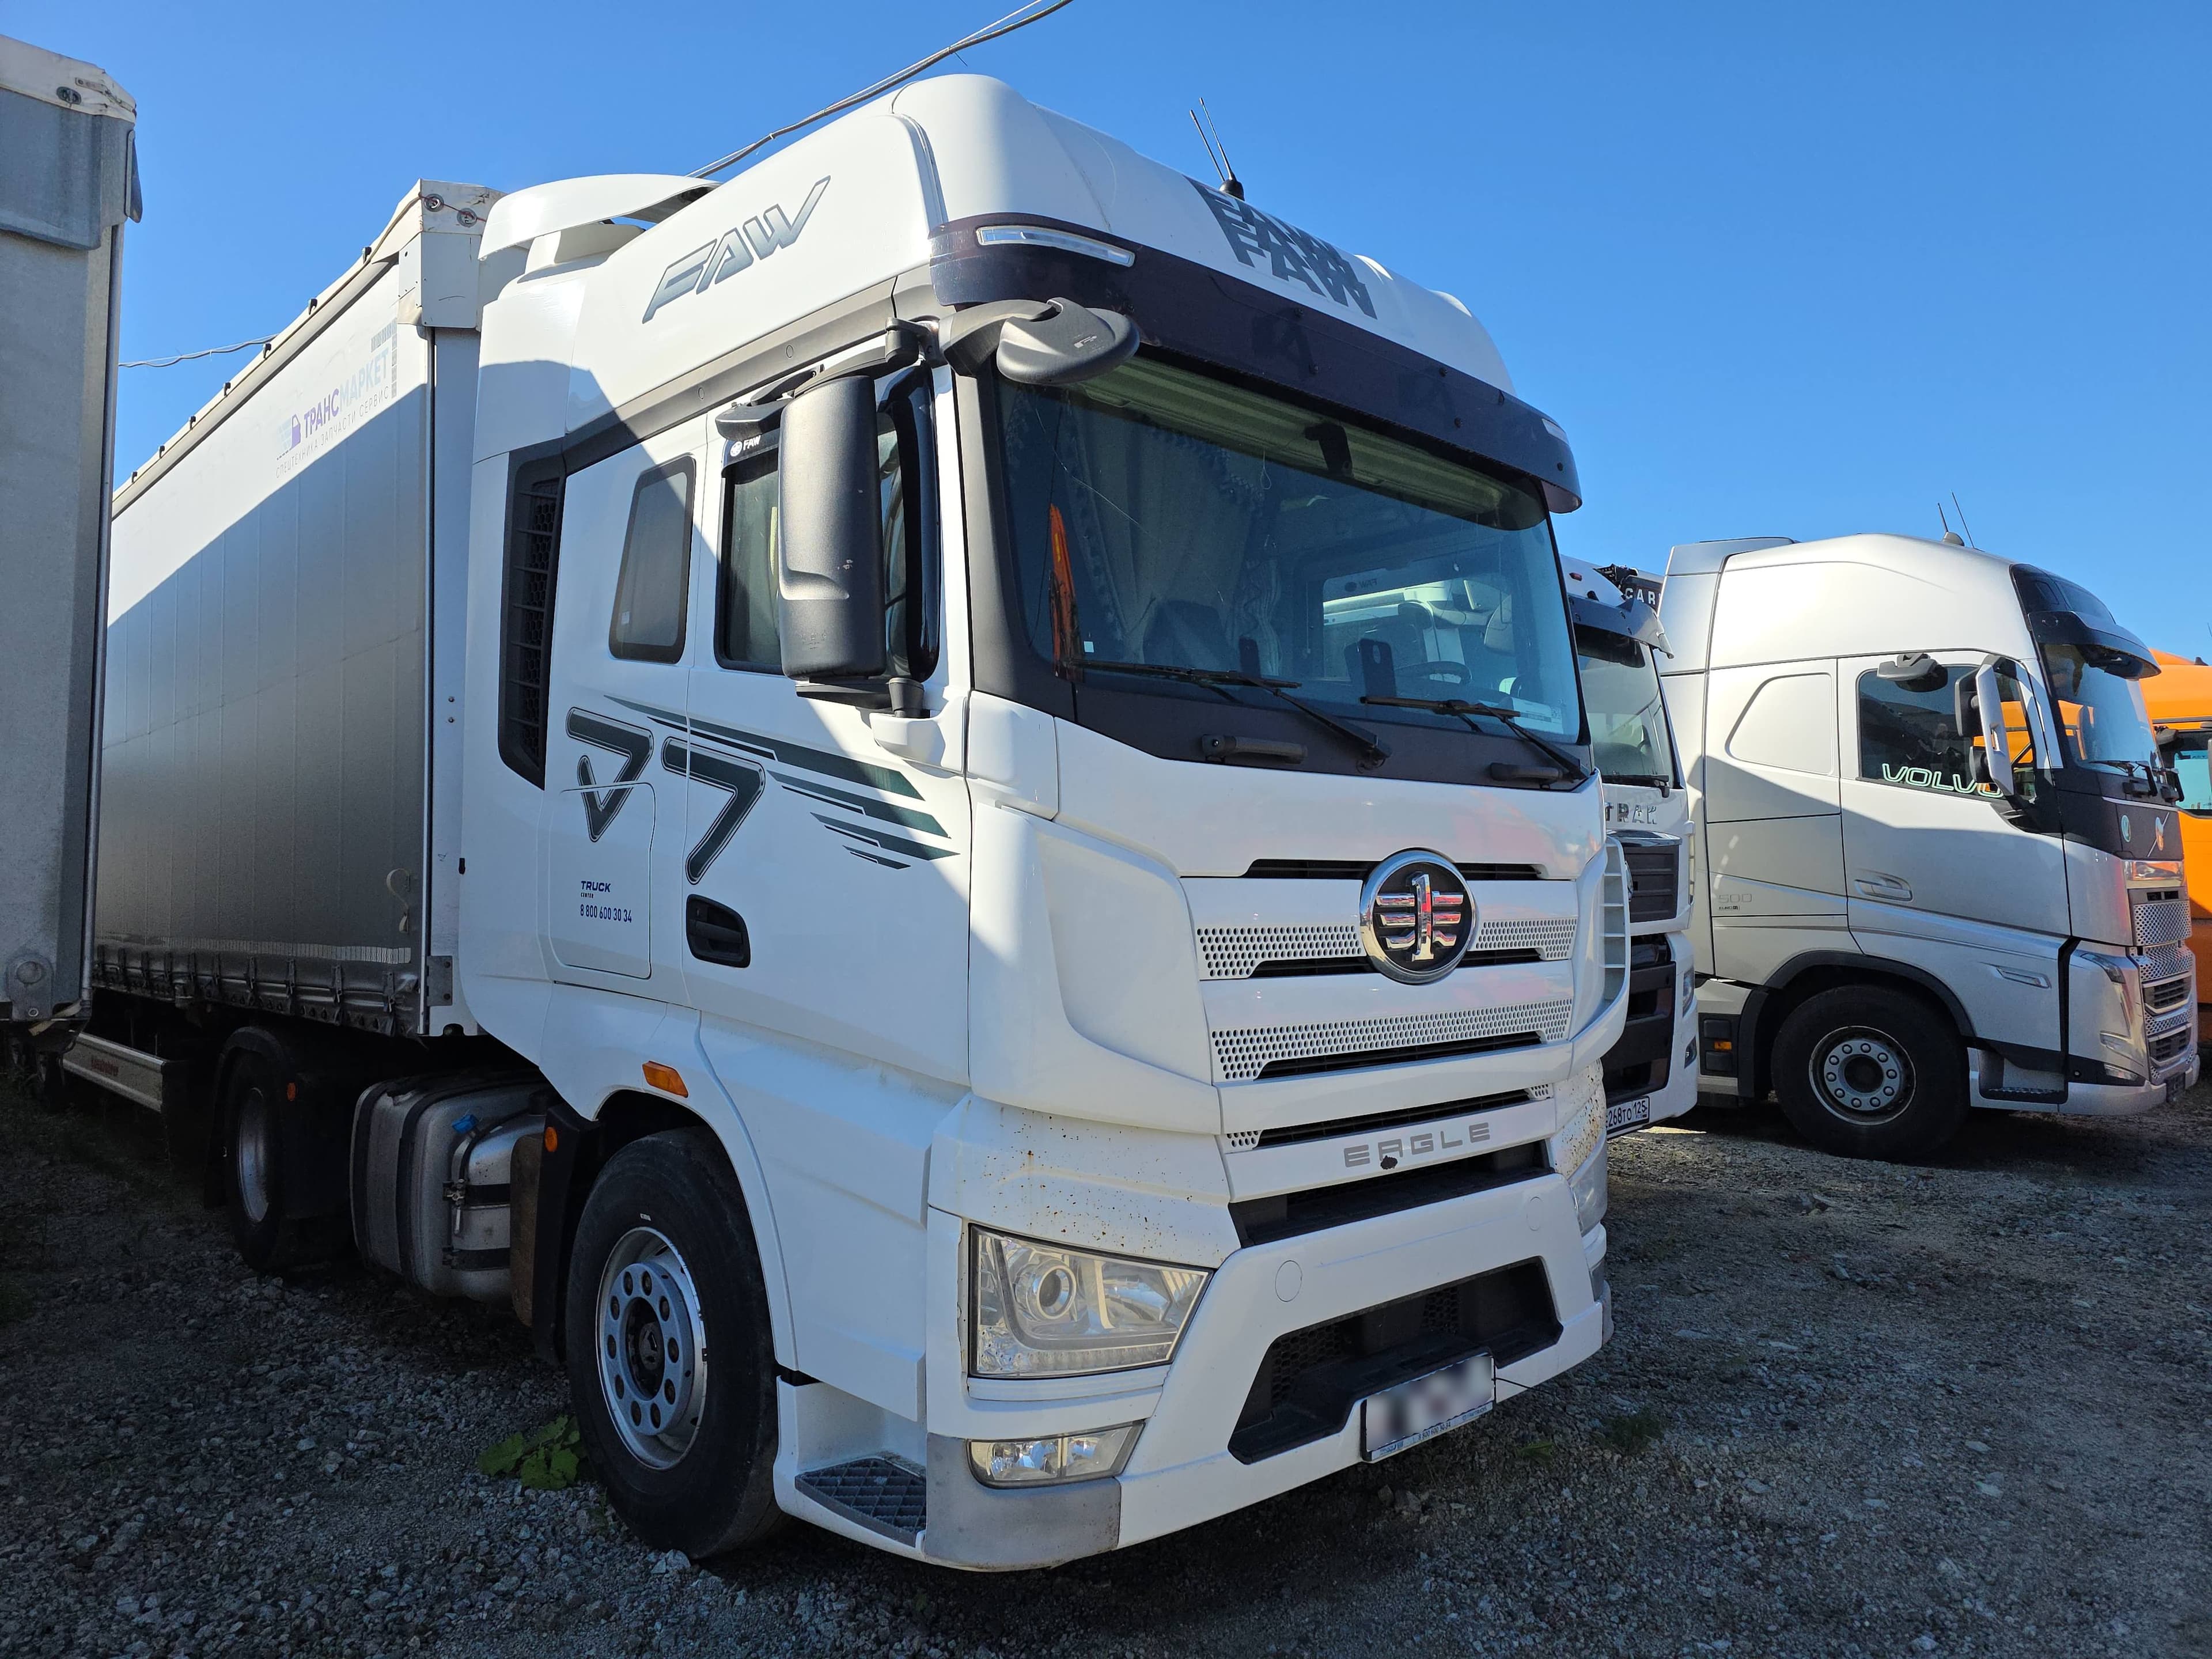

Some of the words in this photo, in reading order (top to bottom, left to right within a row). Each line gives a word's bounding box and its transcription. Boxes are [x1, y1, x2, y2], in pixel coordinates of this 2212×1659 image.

[642, 175, 831, 324] FAW
[304, 347, 389, 438] ТРАНСМАРКЕТ
[276, 441, 318, 478] СПЕЦТЕХНИКА
[321, 410, 355, 445] ЗАПЧАСТИ
[359, 385, 389, 416] СЕРВИС
[743, 435, 761, 450] FAW
[1882, 763, 2004, 798] VOLVO
[581, 881, 611, 892] TRUCK
[1718, 893, 1752, 903] 500
[580, 904, 584, 916] 8
[586, 905, 597, 918] 800
[599, 907, 611, 920] 600
[613, 908, 622, 921] 30
[623, 910, 632, 923] 34
[1634, 1100, 1646, 1115] 125
[1344, 1122, 1490, 1168] EAGLE
